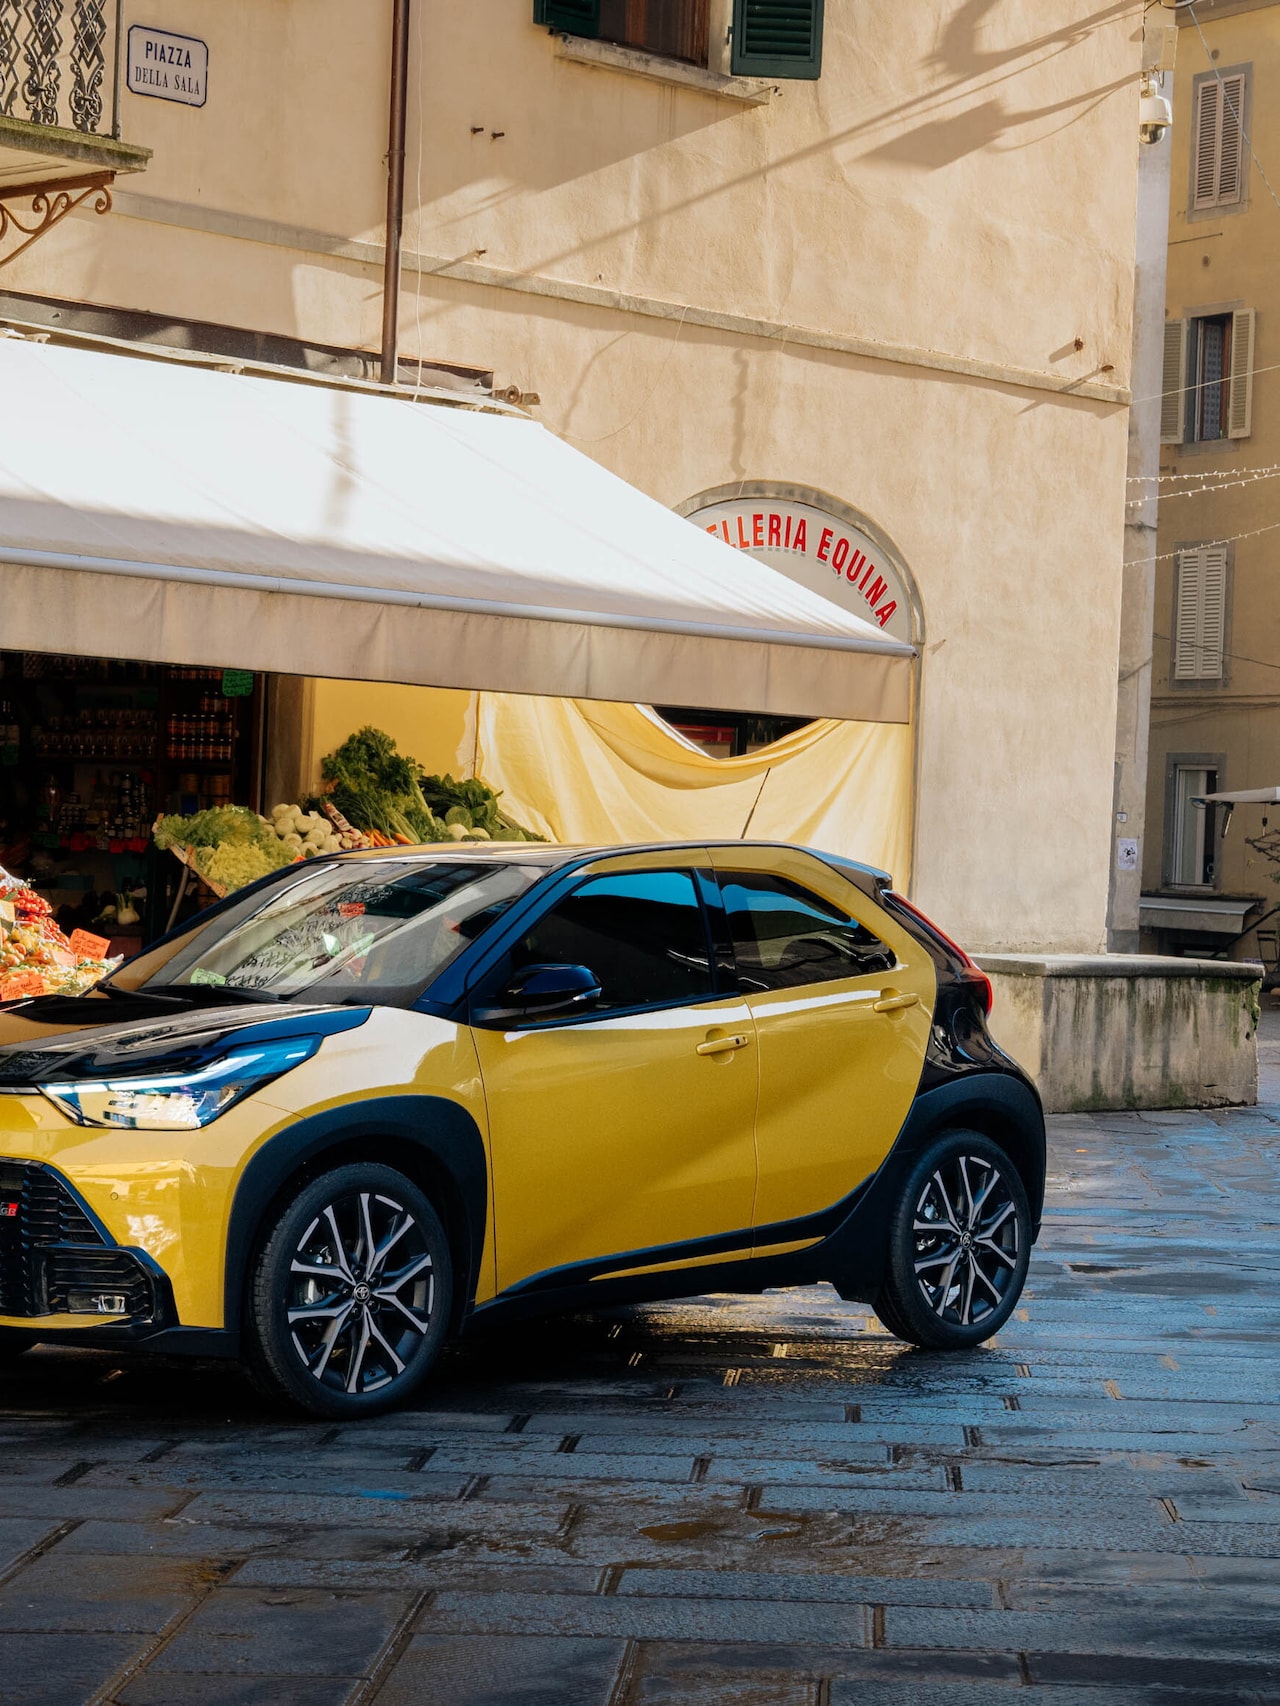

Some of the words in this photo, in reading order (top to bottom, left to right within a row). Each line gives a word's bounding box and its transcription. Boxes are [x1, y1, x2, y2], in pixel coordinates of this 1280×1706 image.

[145, 41, 191, 68] PIAZZA
[135, 66, 169, 88] DELLA
[174, 74, 200, 95] SALA
[816, 527, 898, 628] EQUINA
